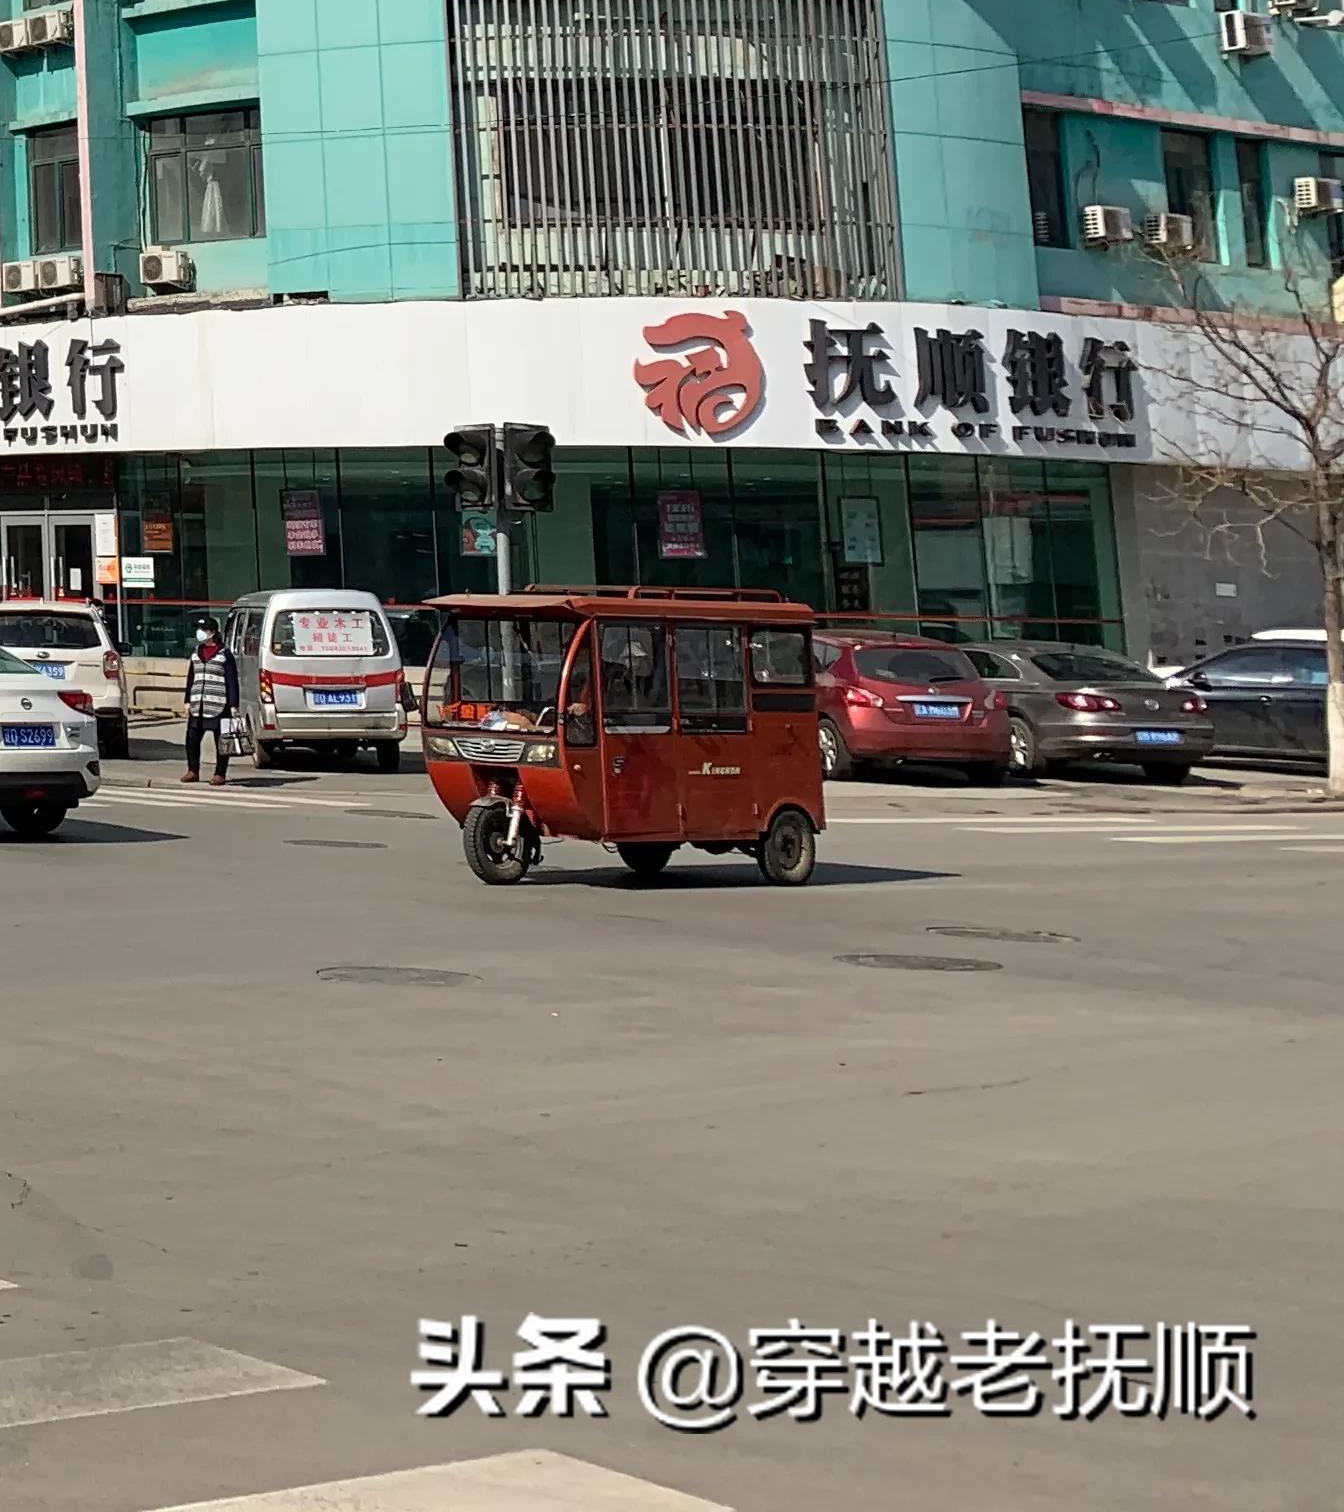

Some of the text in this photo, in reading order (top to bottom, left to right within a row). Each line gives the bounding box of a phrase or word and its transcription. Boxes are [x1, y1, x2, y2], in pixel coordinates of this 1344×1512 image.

[803, 319, 1139, 421] 抚顺银行
[3, 422, 120, 447] FUSHUN
[815, 417, 931, 438] BANK
[951, 422, 1000, 440] OF
